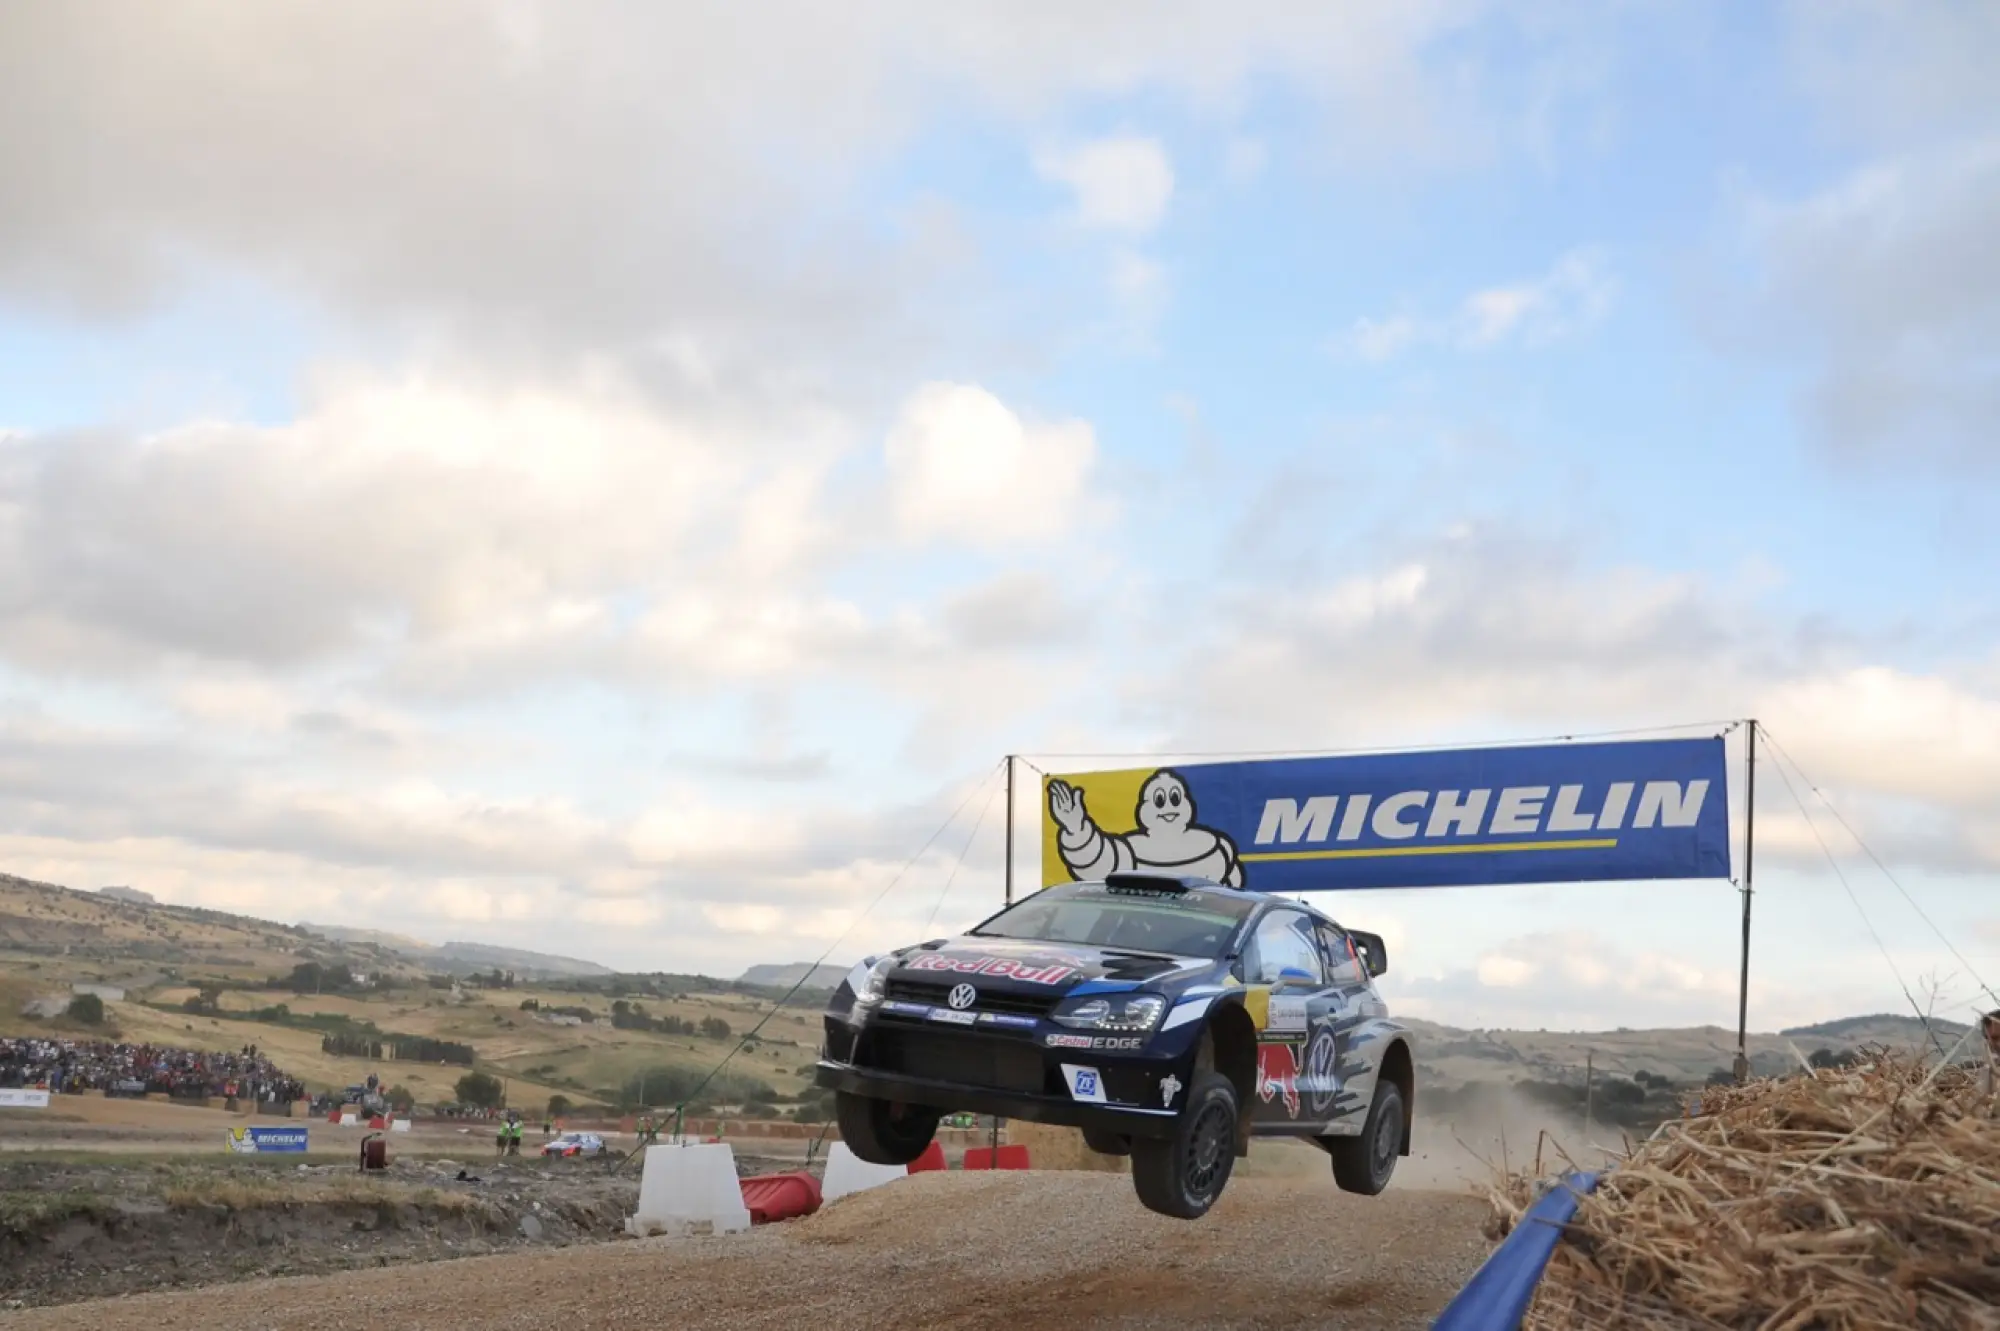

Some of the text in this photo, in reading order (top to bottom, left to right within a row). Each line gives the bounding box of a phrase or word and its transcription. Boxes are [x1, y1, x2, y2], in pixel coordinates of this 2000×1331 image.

[1255, 779, 1710, 844] MICHELIN
[907, 954, 1076, 985] Red Bull
[1092, 1037, 1142, 1049] EDGE
[257, 1135, 306, 1143] MICHELIN
